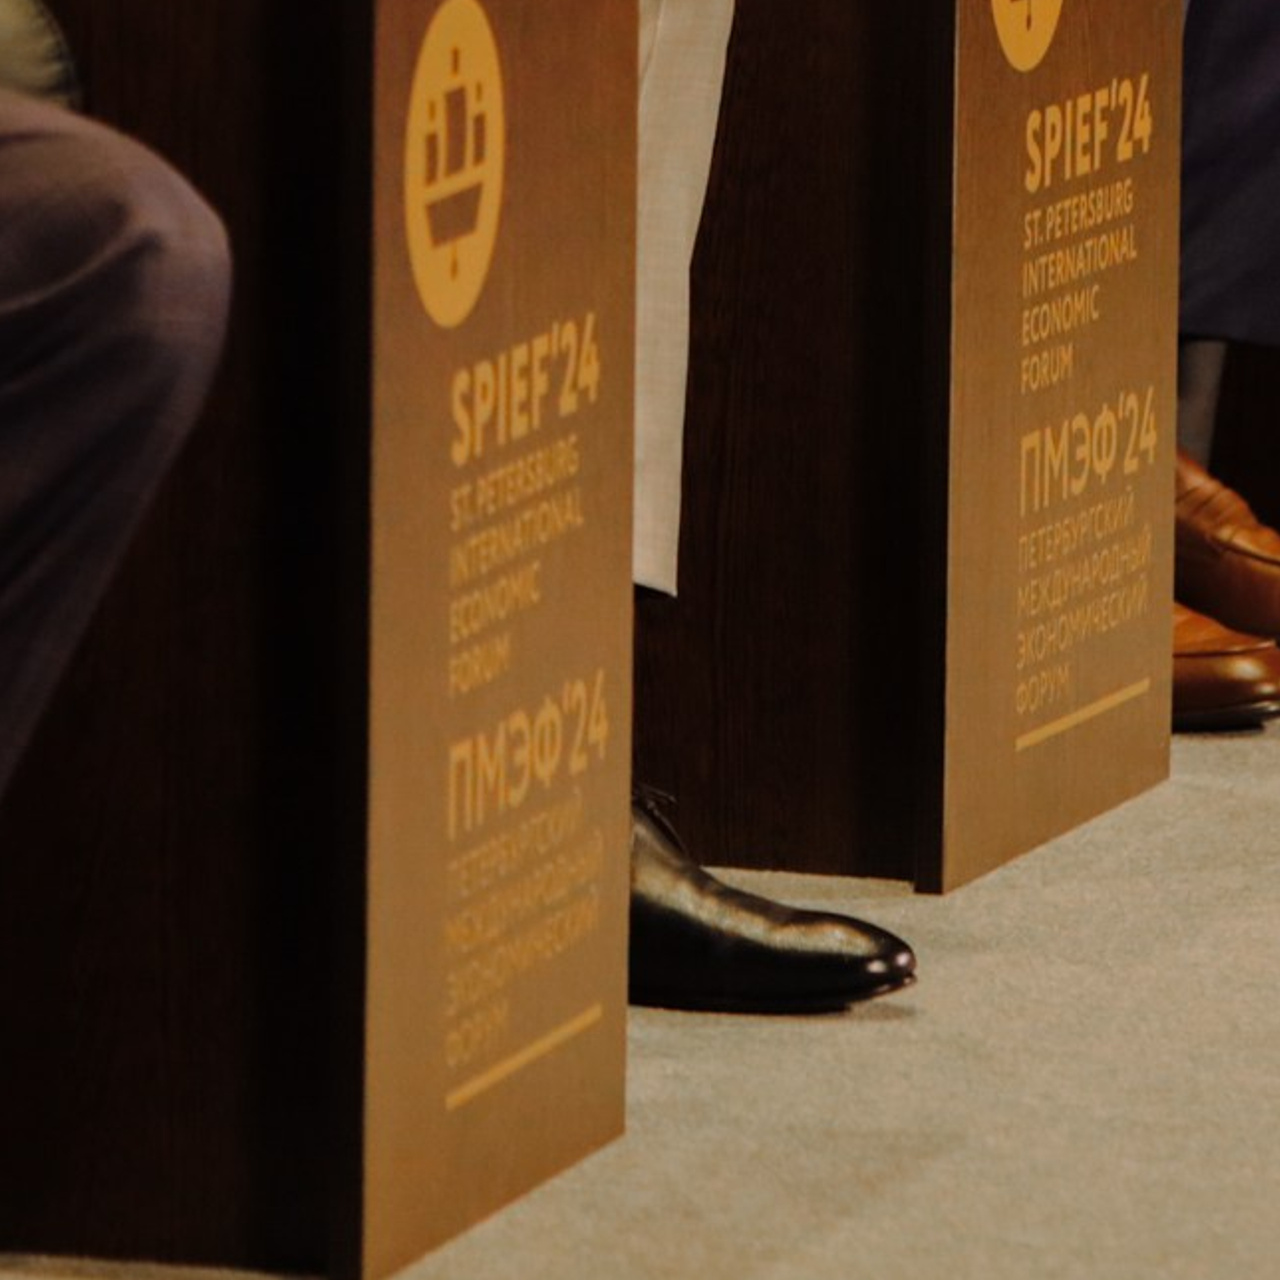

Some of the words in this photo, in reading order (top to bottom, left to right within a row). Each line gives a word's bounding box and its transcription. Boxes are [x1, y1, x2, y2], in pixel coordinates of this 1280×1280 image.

[1024, 73, 1153, 194] SPIEF'24
[1045, 178, 1134, 241] PETERSBURG
[1022, 224, 1138, 298] INTERNATIONAL
[1022, 284, 1100, 347] ECONOMIC
[450, 312, 602, 468] SPIEF'24
[1021, 342, 1074, 395] FORUM
[1020, 386, 1158, 517] ПМЭФ'24
[1019, 485, 1135, 573] ПЕТЕРБУРГСКИЙ
[1015, 662, 1071, 716] ФОРУМ
[448, 669, 609, 840] ПМЭФ'24
